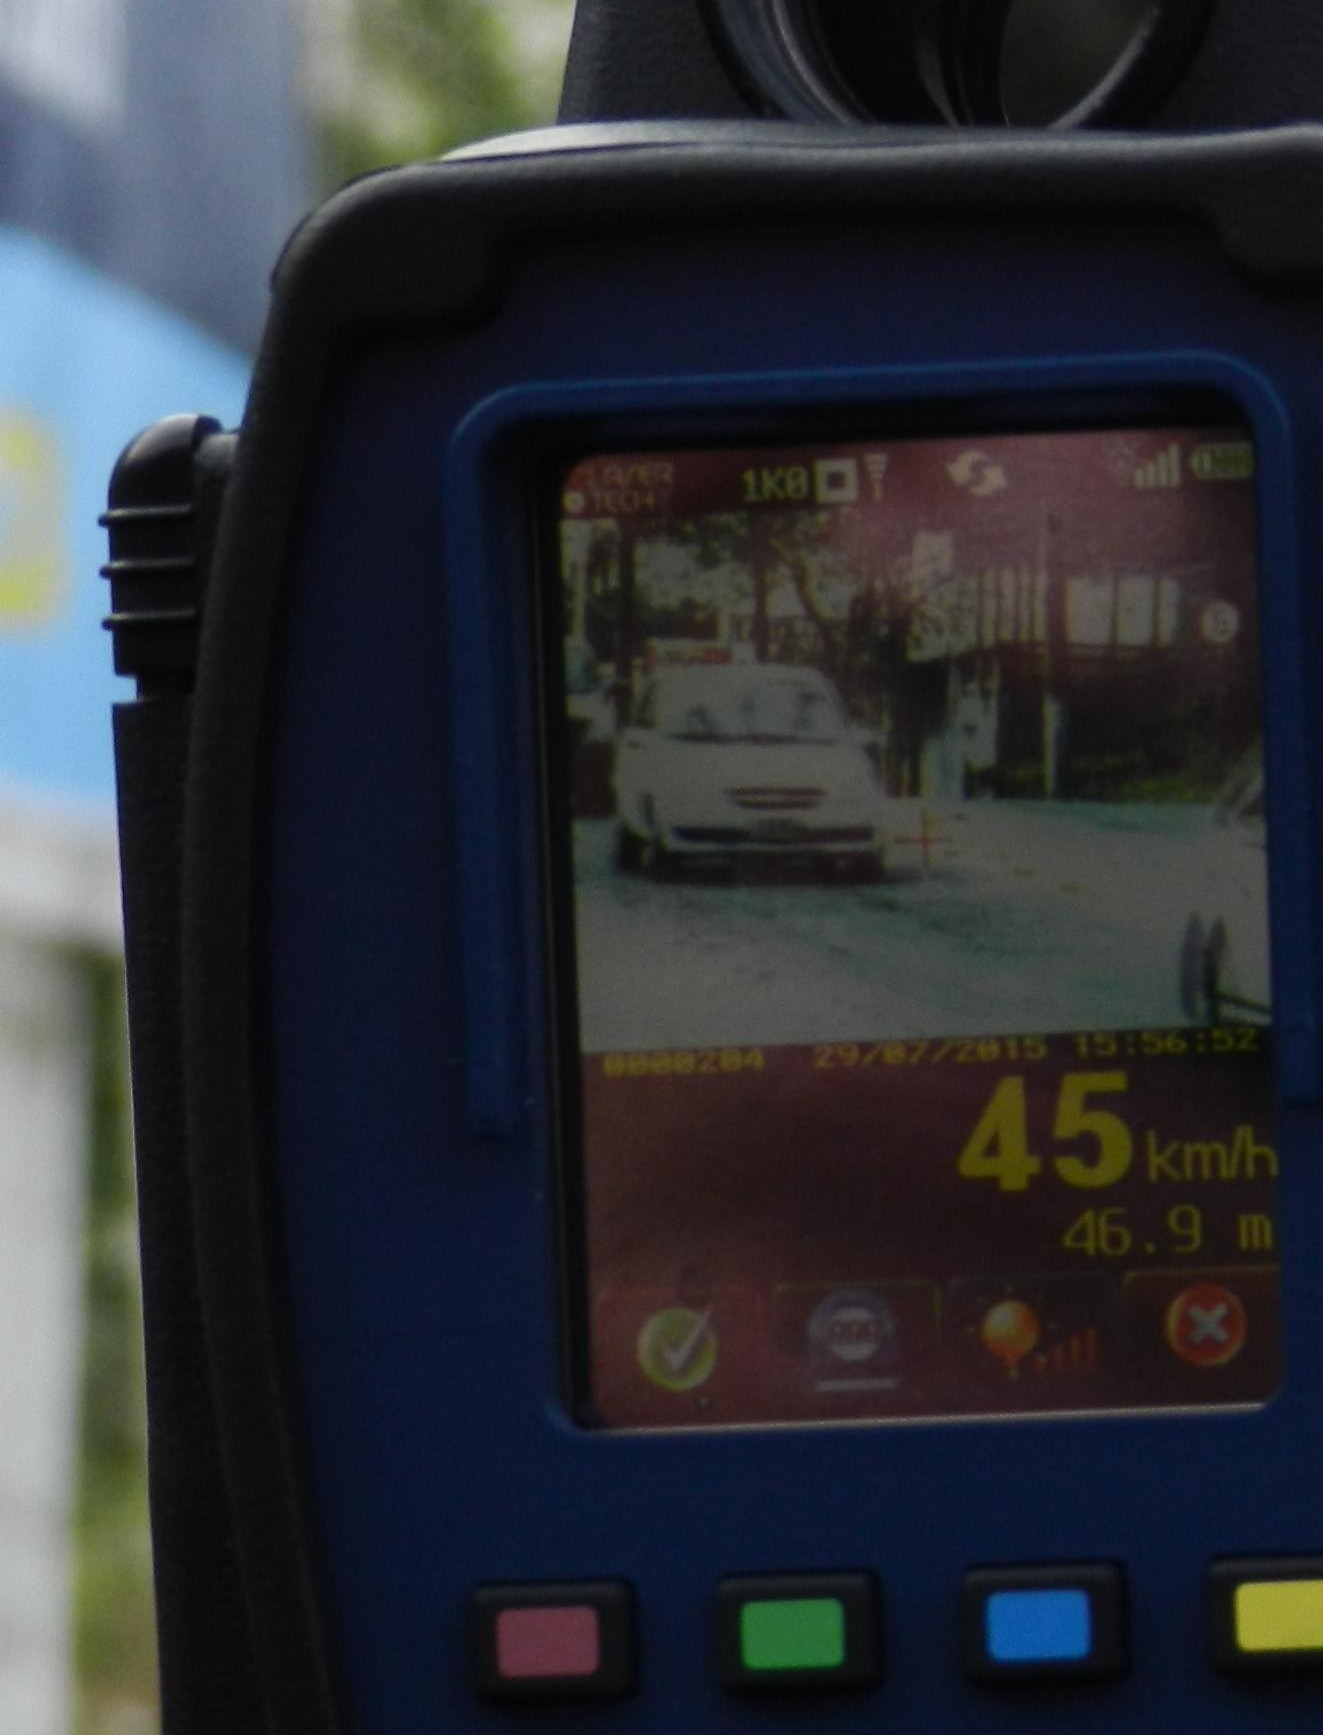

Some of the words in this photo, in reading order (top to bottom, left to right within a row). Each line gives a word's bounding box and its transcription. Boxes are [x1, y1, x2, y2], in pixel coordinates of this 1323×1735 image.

[591, 491, 656, 511] TECH
[814, 1033, 1047, 1068] 29/07/2015
[1074, 1028, 1257, 1058] 15:56:52
[957, 1070, 1134, 1191] 45
[1145, 1125, 1278, 1183] km/h
[1063, 1205, 1201, 1258] 46.9
[1237, 1213, 1274, 1250] m
